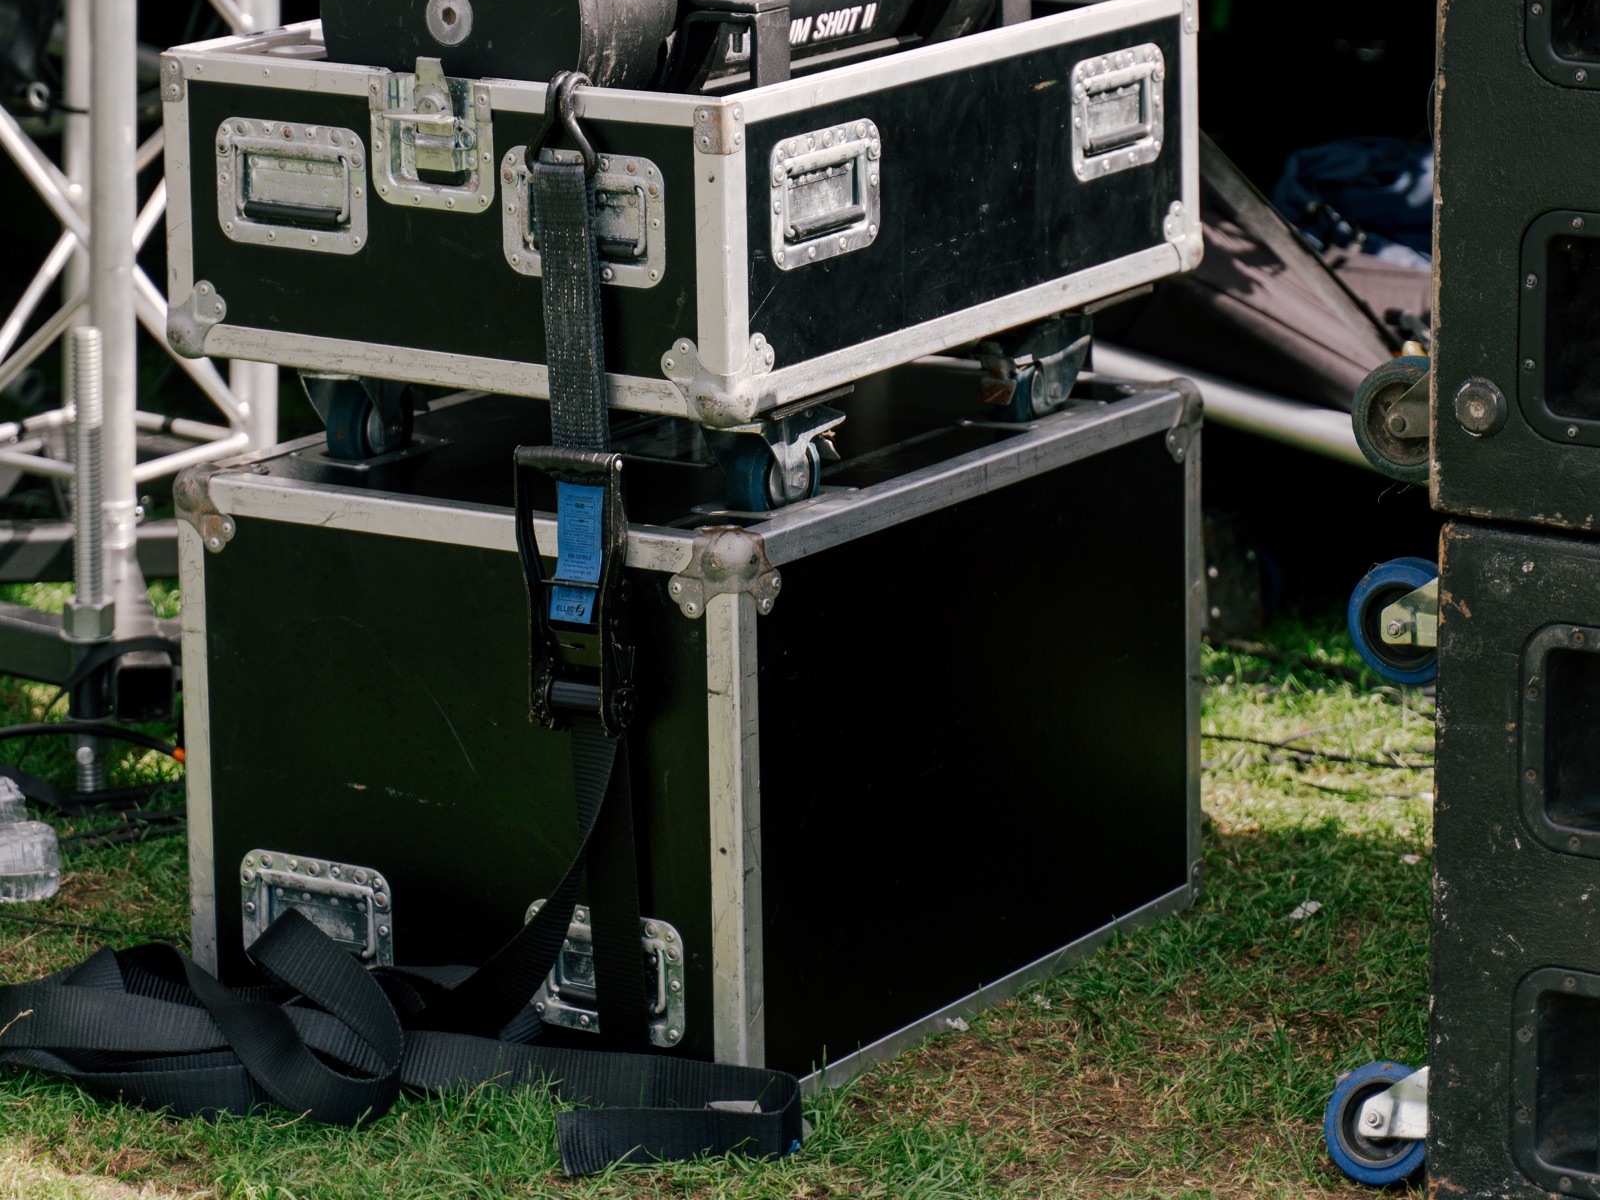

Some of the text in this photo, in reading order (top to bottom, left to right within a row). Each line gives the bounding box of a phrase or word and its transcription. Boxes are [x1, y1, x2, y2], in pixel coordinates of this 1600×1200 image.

[813, 6, 862, 39] SHOT
[860, 2, 877, 30] II
[556, 604, 575, 613] ELLER
